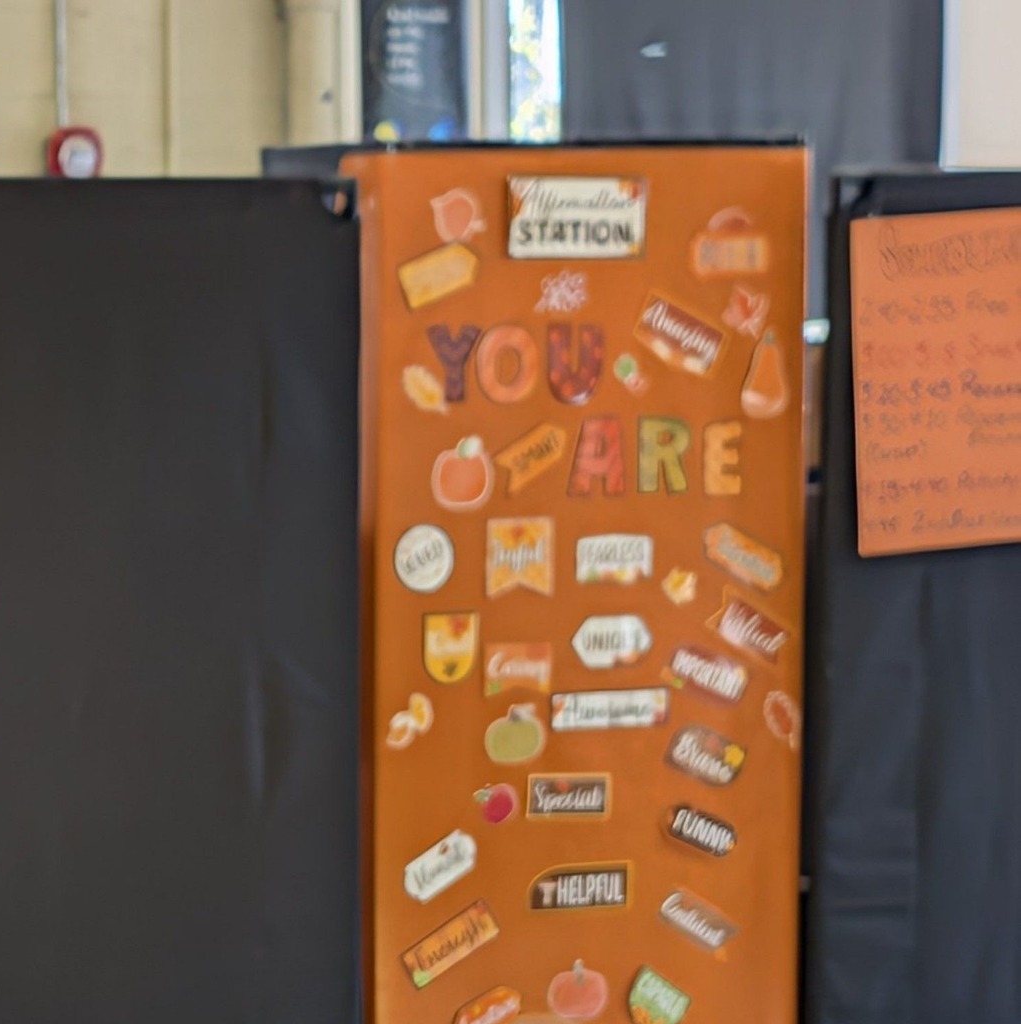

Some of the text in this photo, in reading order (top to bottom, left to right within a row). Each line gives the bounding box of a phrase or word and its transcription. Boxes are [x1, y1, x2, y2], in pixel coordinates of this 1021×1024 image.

[518, 220, 635, 245] STATION
[426, 323, 607, 406] YOU
[567, 414, 743, 497] ARE
[556, 872, 625, 908] HELPFUL
